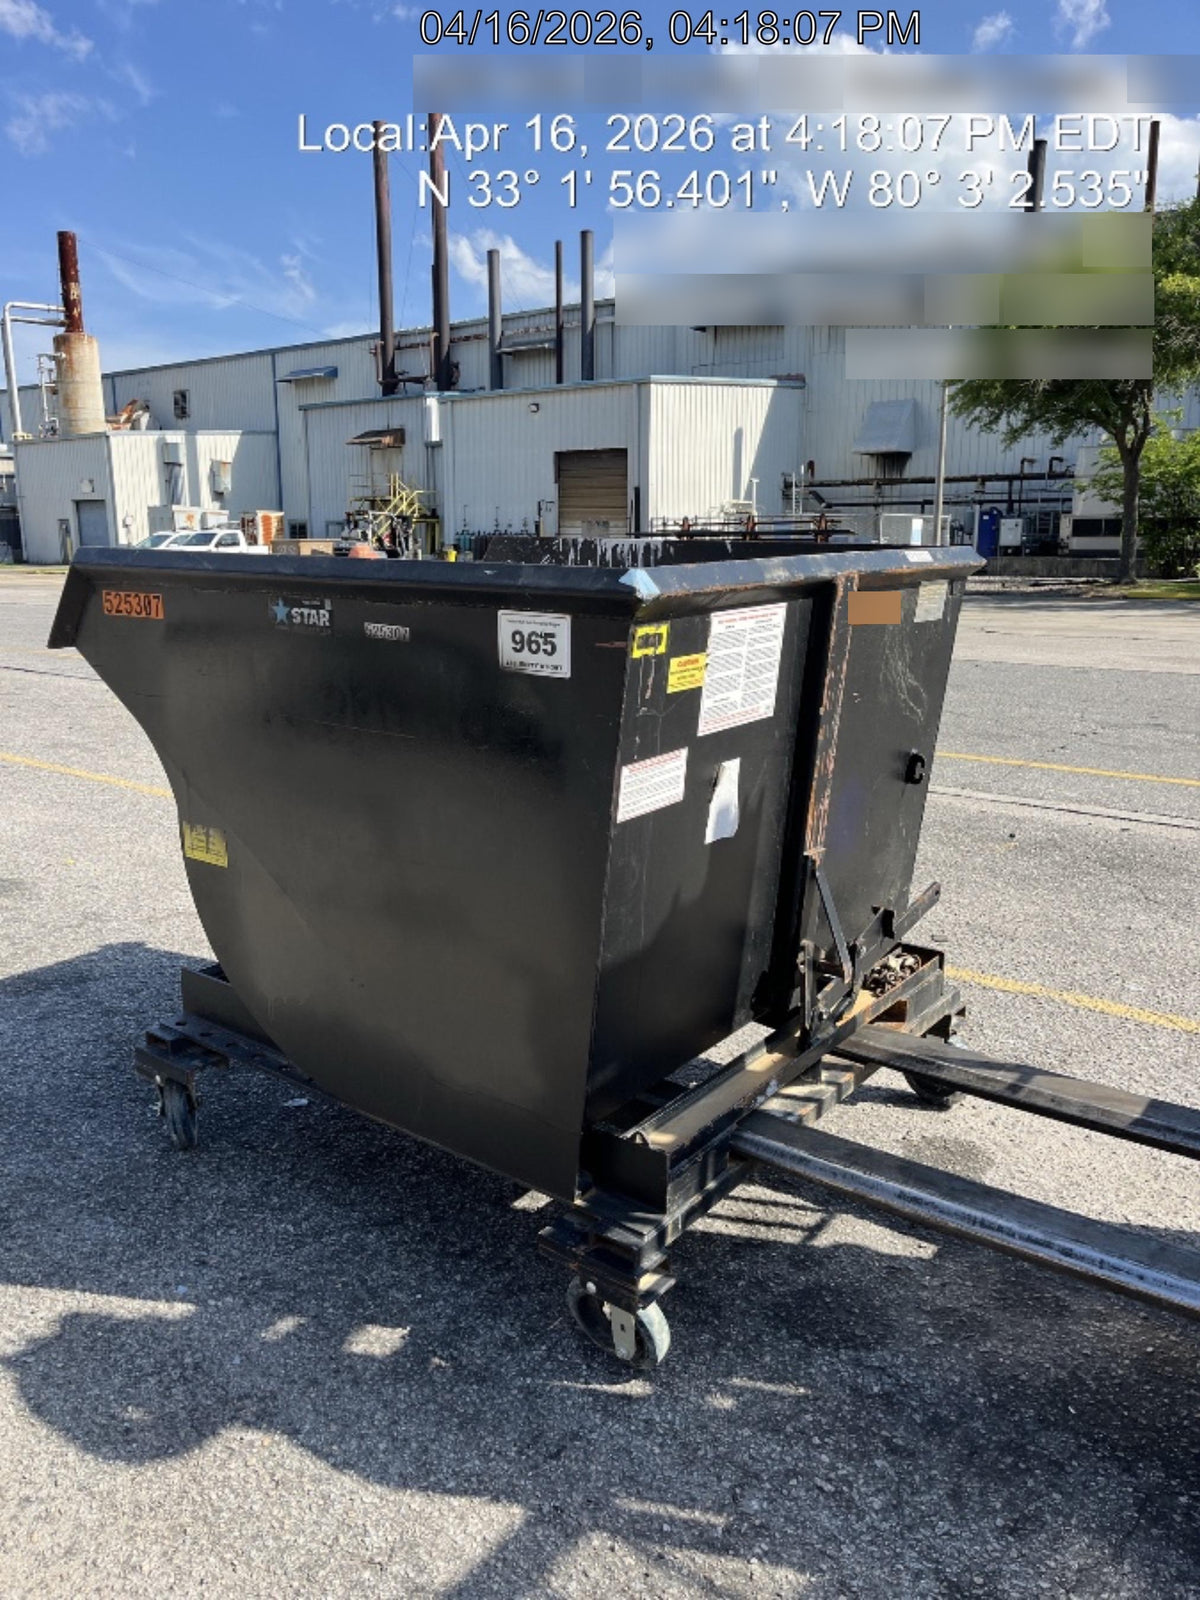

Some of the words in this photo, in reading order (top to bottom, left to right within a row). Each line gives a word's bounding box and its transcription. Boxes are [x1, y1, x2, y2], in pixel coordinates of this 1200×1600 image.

[104, 591, 161, 618] 525307
[290, 607, 330, 627] STAR
[511, 629, 557, 657] 965
